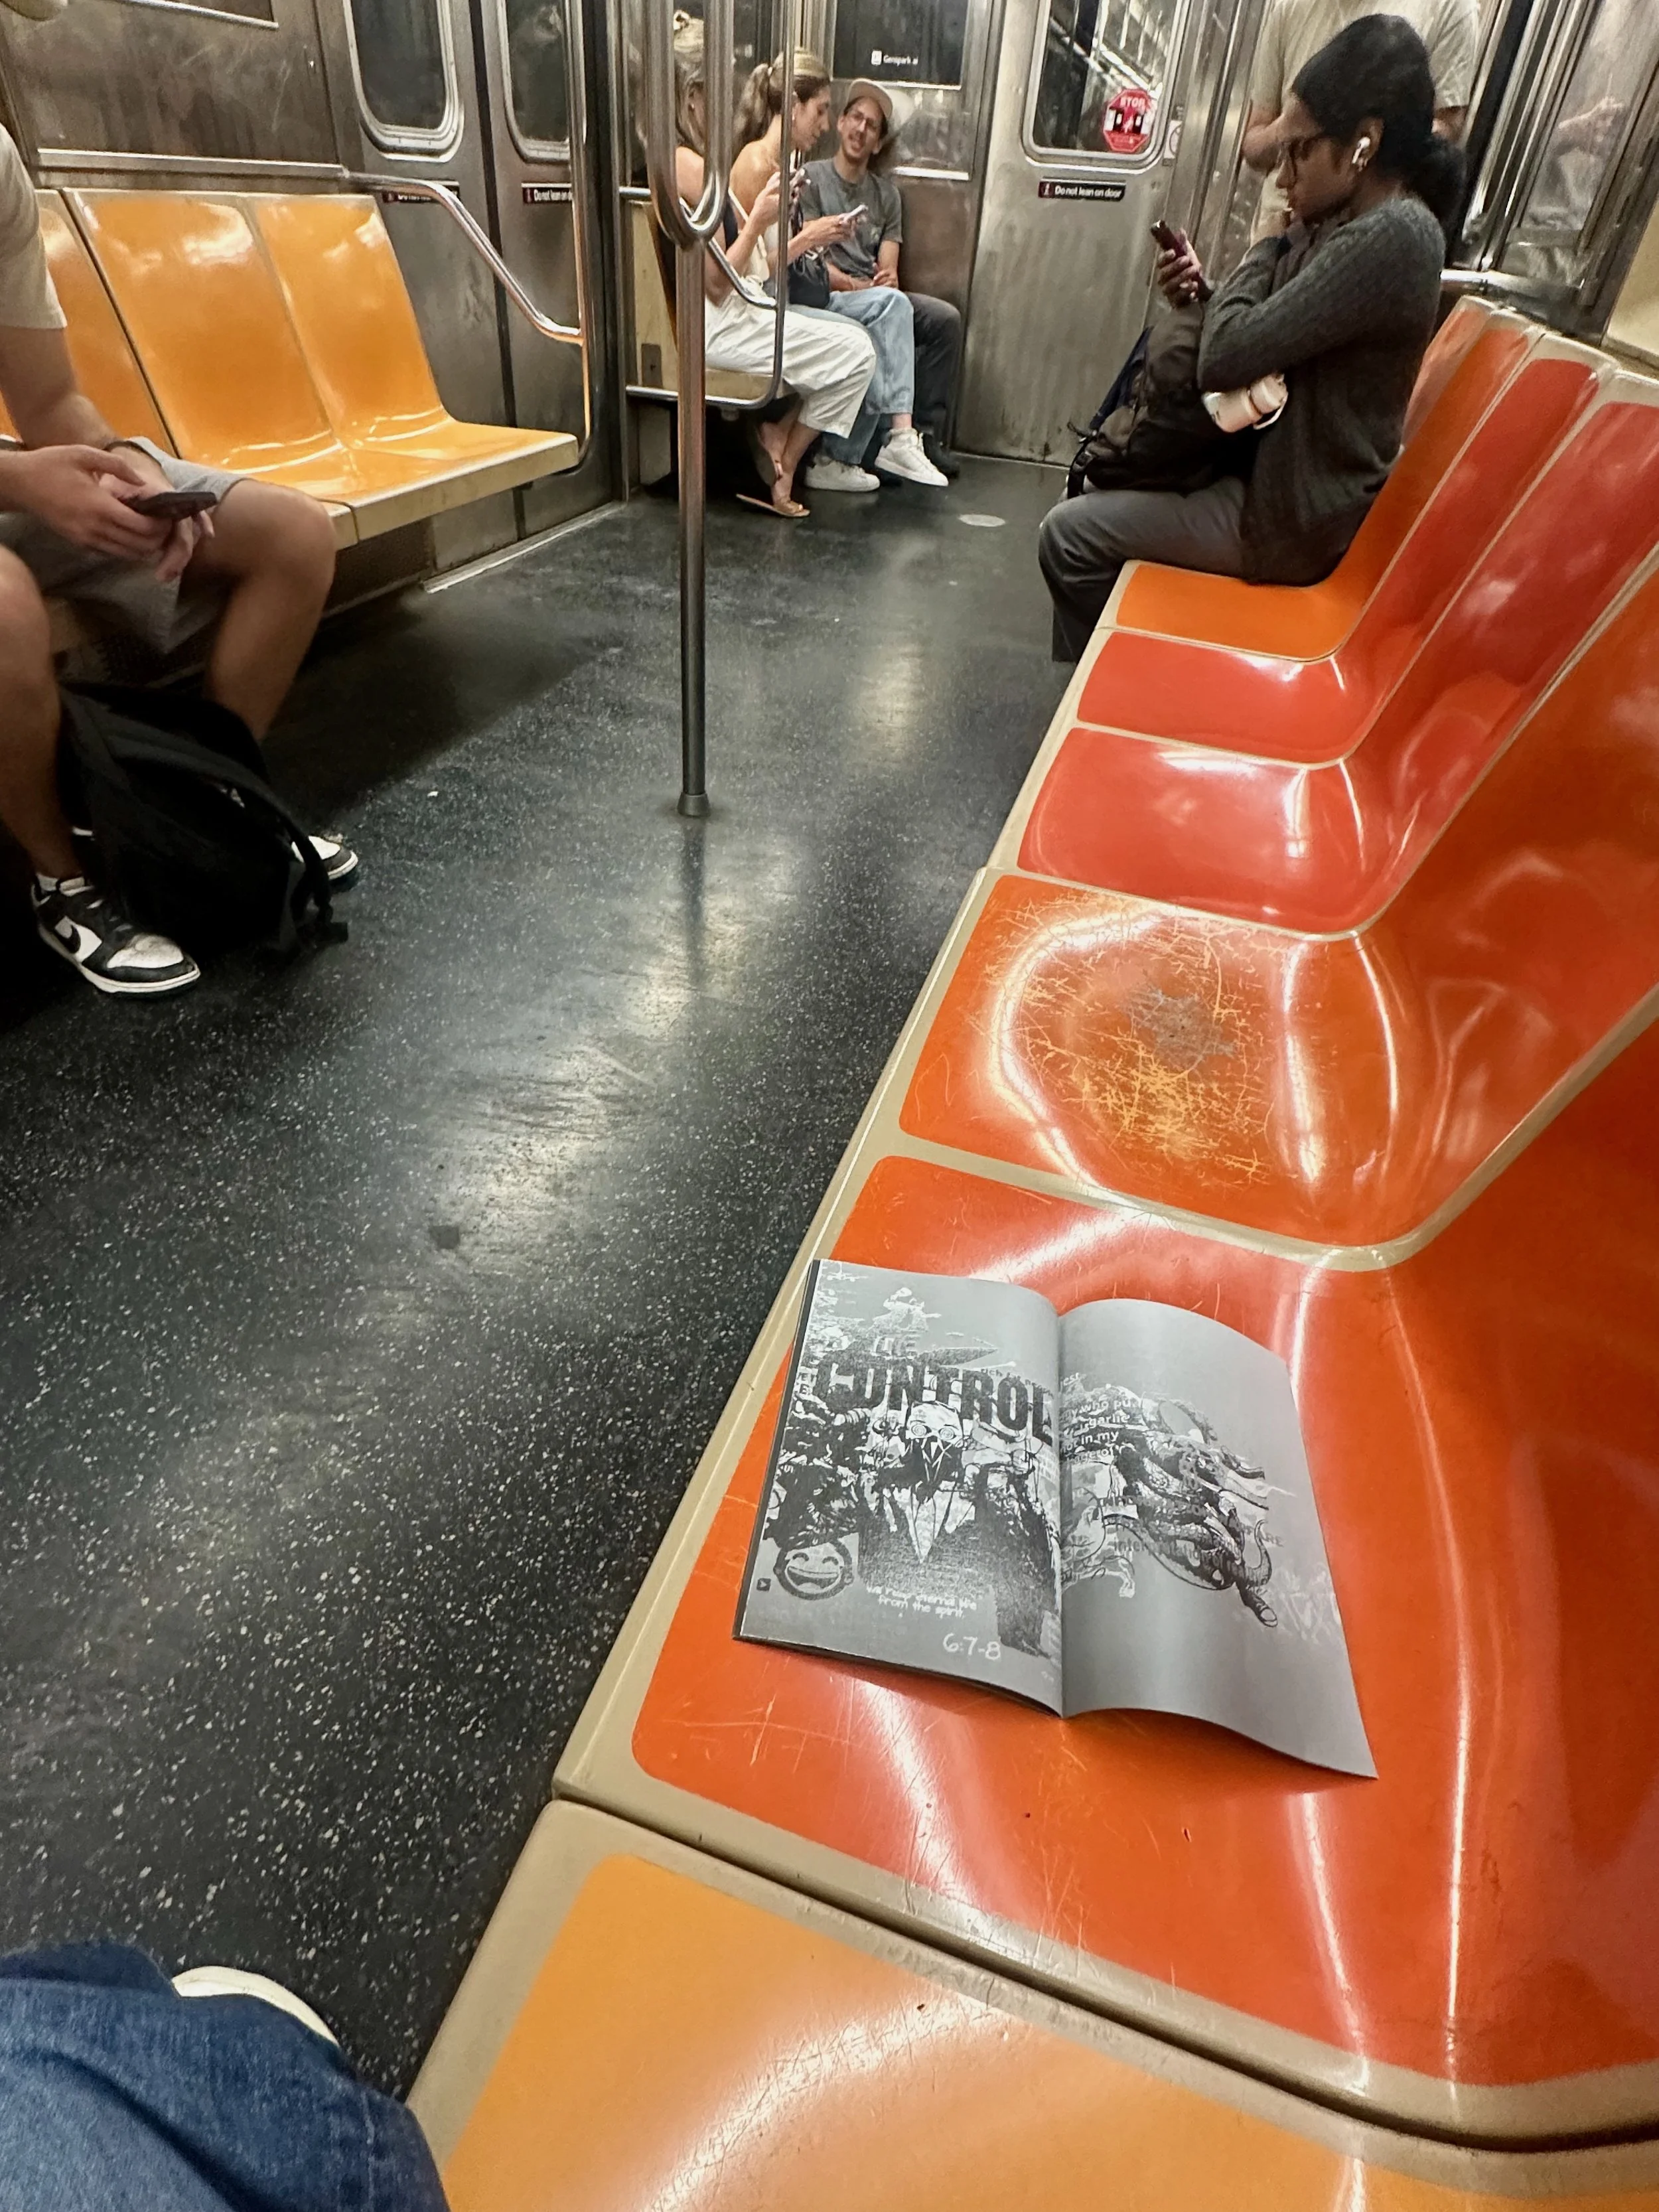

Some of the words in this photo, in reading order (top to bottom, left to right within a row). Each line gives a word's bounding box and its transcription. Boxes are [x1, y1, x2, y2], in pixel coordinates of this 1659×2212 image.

[1055, 185, 1066, 195] Do
[1066, 186, 1078, 196] not
[1104, 188, 1121, 198] door
[1081, 1399, 1109, 1413] who
[1089, 1412, 1130, 1428] garlic
[1081, 1435, 1093, 1444] in
[1097, 1431, 1119, 1442] my
[912, 1600, 931, 1613] the
[942, 1633, 1001, 1660] 6:7-8
